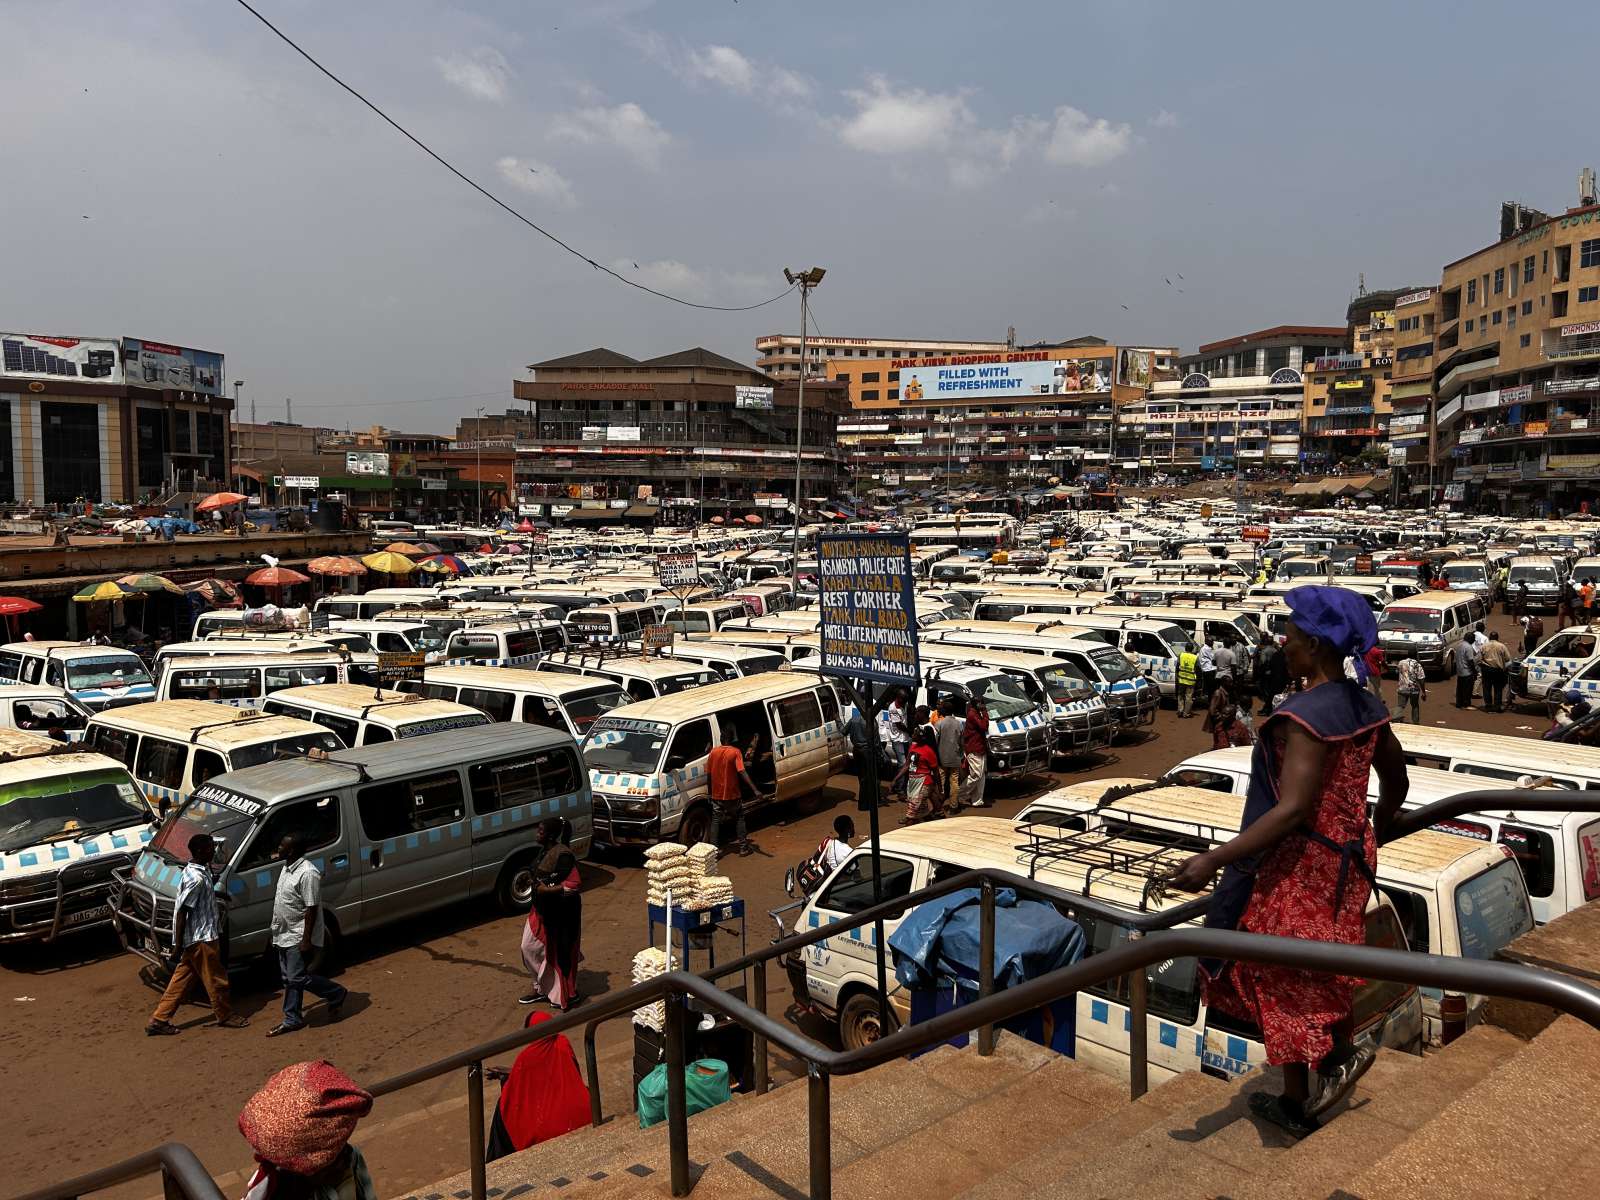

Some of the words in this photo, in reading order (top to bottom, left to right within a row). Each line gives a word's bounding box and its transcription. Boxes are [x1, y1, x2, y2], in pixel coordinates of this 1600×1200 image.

[1563, 322, 1600, 335] DIAMONDS
[891, 360, 917, 368] PARK
[922, 358, 947, 367] VIEW
[951, 355, 1001, 365] SHOPPING
[1007, 352, 1049, 362] CENTRE
[938, 368, 977, 379] FILLED
[979, 367, 1009, 378] WITH
[938, 378, 1023, 391] REFRESHMENT
[859, 557, 886, 575] POLICE
[887, 557, 906, 575] GATE
[823, 575, 903, 592] KABALAGALA
[823, 592, 849, 607] REST
[854, 592, 903, 609] CORNER
[824, 607, 851, 624] TANK
[824, 624, 847, 640] HOTEL
[847, 626, 914, 647] INTERNATIONAL
[824, 640, 878, 658] CORNERSTONE
[826, 654, 864, 669] BUKASA
[871, 659, 916, 677] MWAALO
[240, 709, 257, 718] TAXI
[73, 911, 91, 922] UAG
